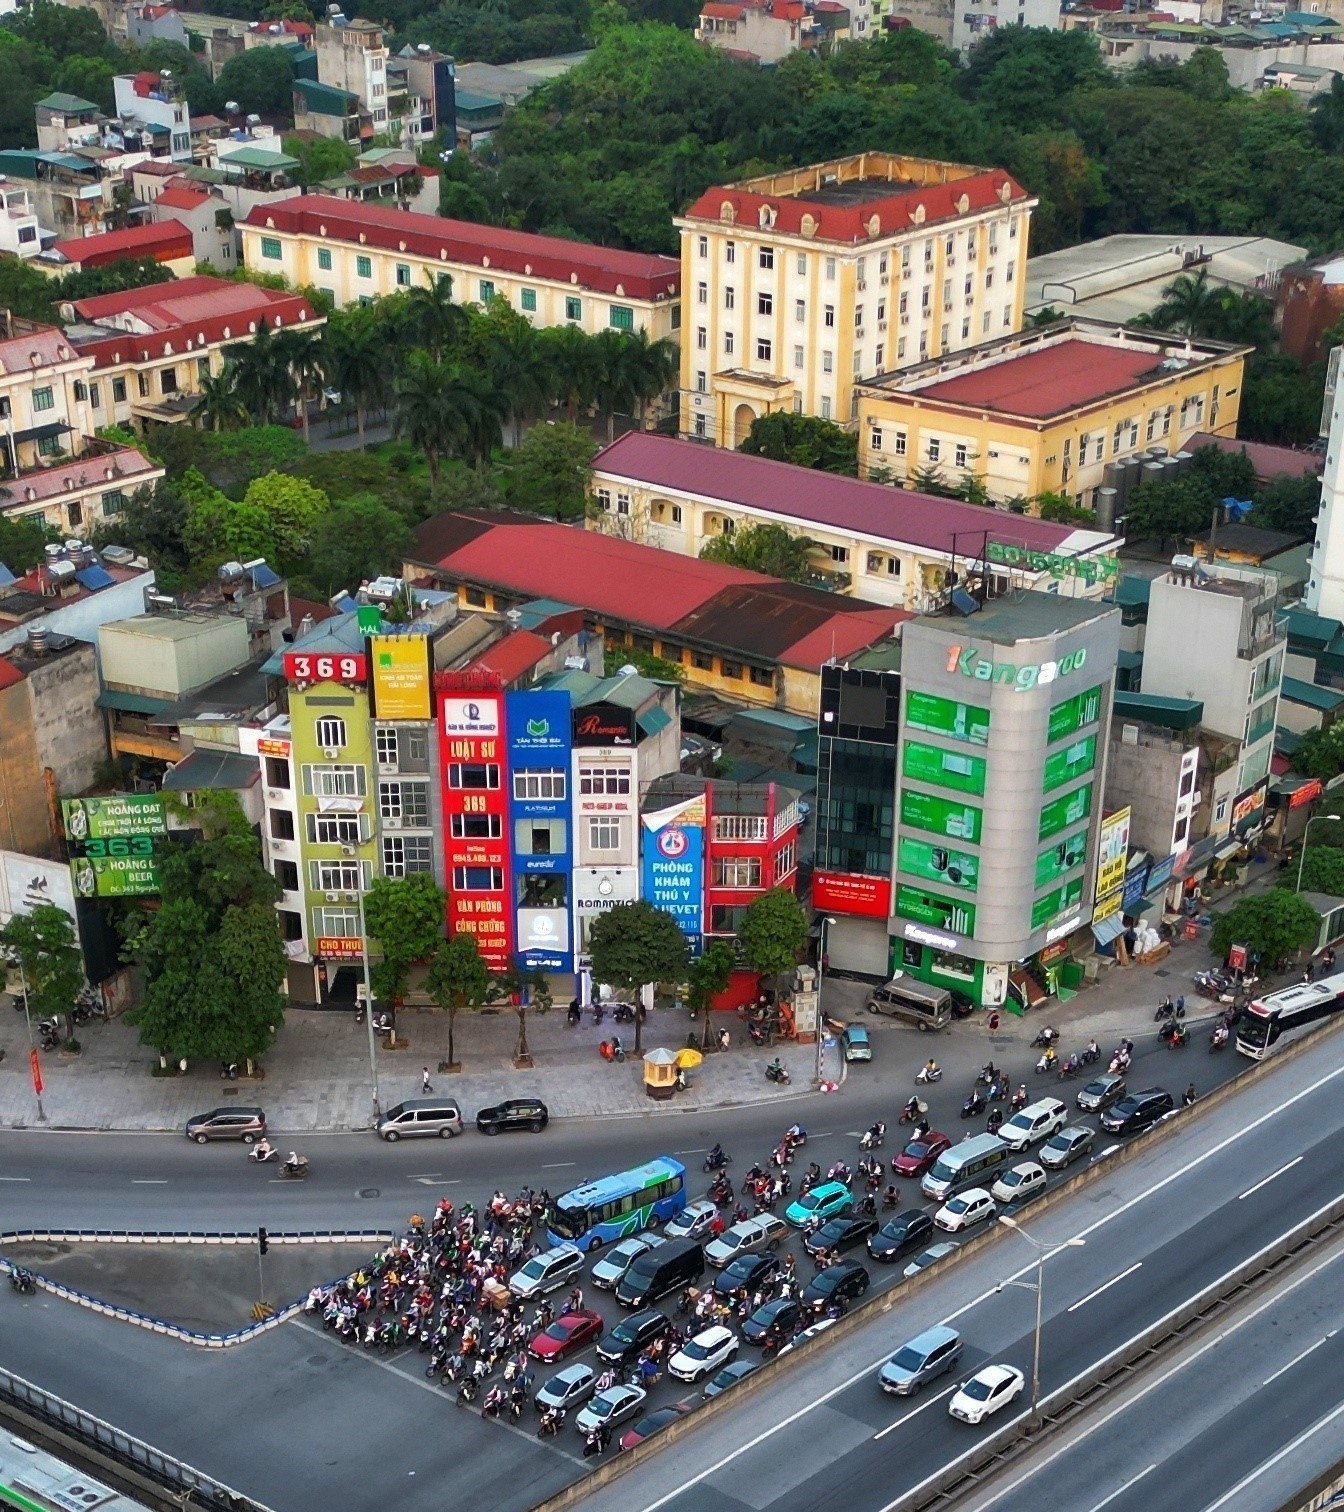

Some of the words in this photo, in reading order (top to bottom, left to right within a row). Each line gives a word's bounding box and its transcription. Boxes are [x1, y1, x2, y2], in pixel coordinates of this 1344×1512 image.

[294, 657, 357, 678] 369
[946, 643, 1087, 692] Kangaroo
[450, 738, 475, 761] LUẬT
[481, 739, 496, 758] SƯ
[463, 795, 486, 812] 369
[107, 804, 142, 816] HOÀNG
[84, 837, 153, 857] 363
[110, 859, 147, 871] HOÀNG
[652, 860, 693, 873] PHÒNG
[128, 872, 153, 881] BEER
[654, 876, 691, 887] KHÁM
[654, 889, 679, 901] THÚ
[682, 890, 689, 901] Y
[320, 940, 339, 950] CHO
